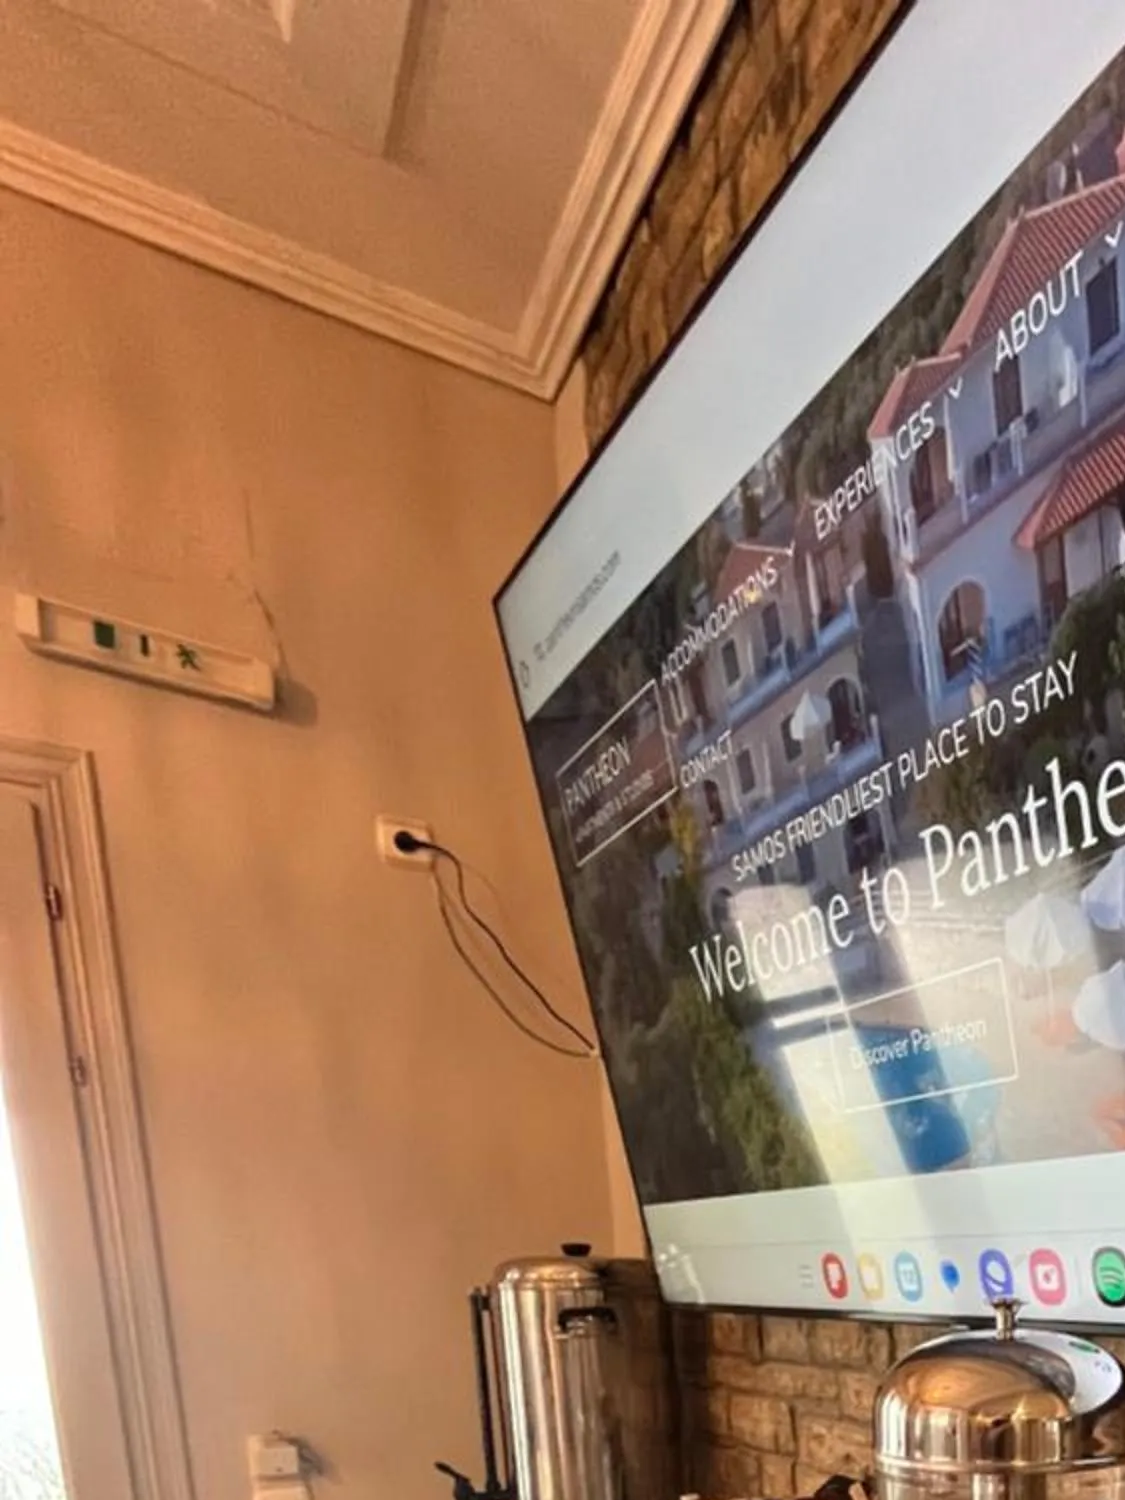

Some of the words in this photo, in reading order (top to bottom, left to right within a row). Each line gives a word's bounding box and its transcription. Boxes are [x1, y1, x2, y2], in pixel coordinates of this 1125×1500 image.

[994, 251, 1085, 371] ABOUT
[814, 402, 935, 540] EXPERIENCES
[661, 556, 779, 683] ACCOMMODATIONS
[565, 736, 631, 816] PANTHEON
[680, 729, 733, 788] CONTACT
[732, 832, 786, 882] SAMOS
[786, 761, 894, 855] FRIENDLIEST
[899, 727, 967, 790] PLACE
[969, 698, 1006, 745] TO
[1011, 650, 1078, 724] STAY
[688, 894, 851, 1003] Welcome
[861, 866, 910, 930] to
[850, 1036, 910, 1070] Discover
[910, 1020, 988, 1055] Pantheon
